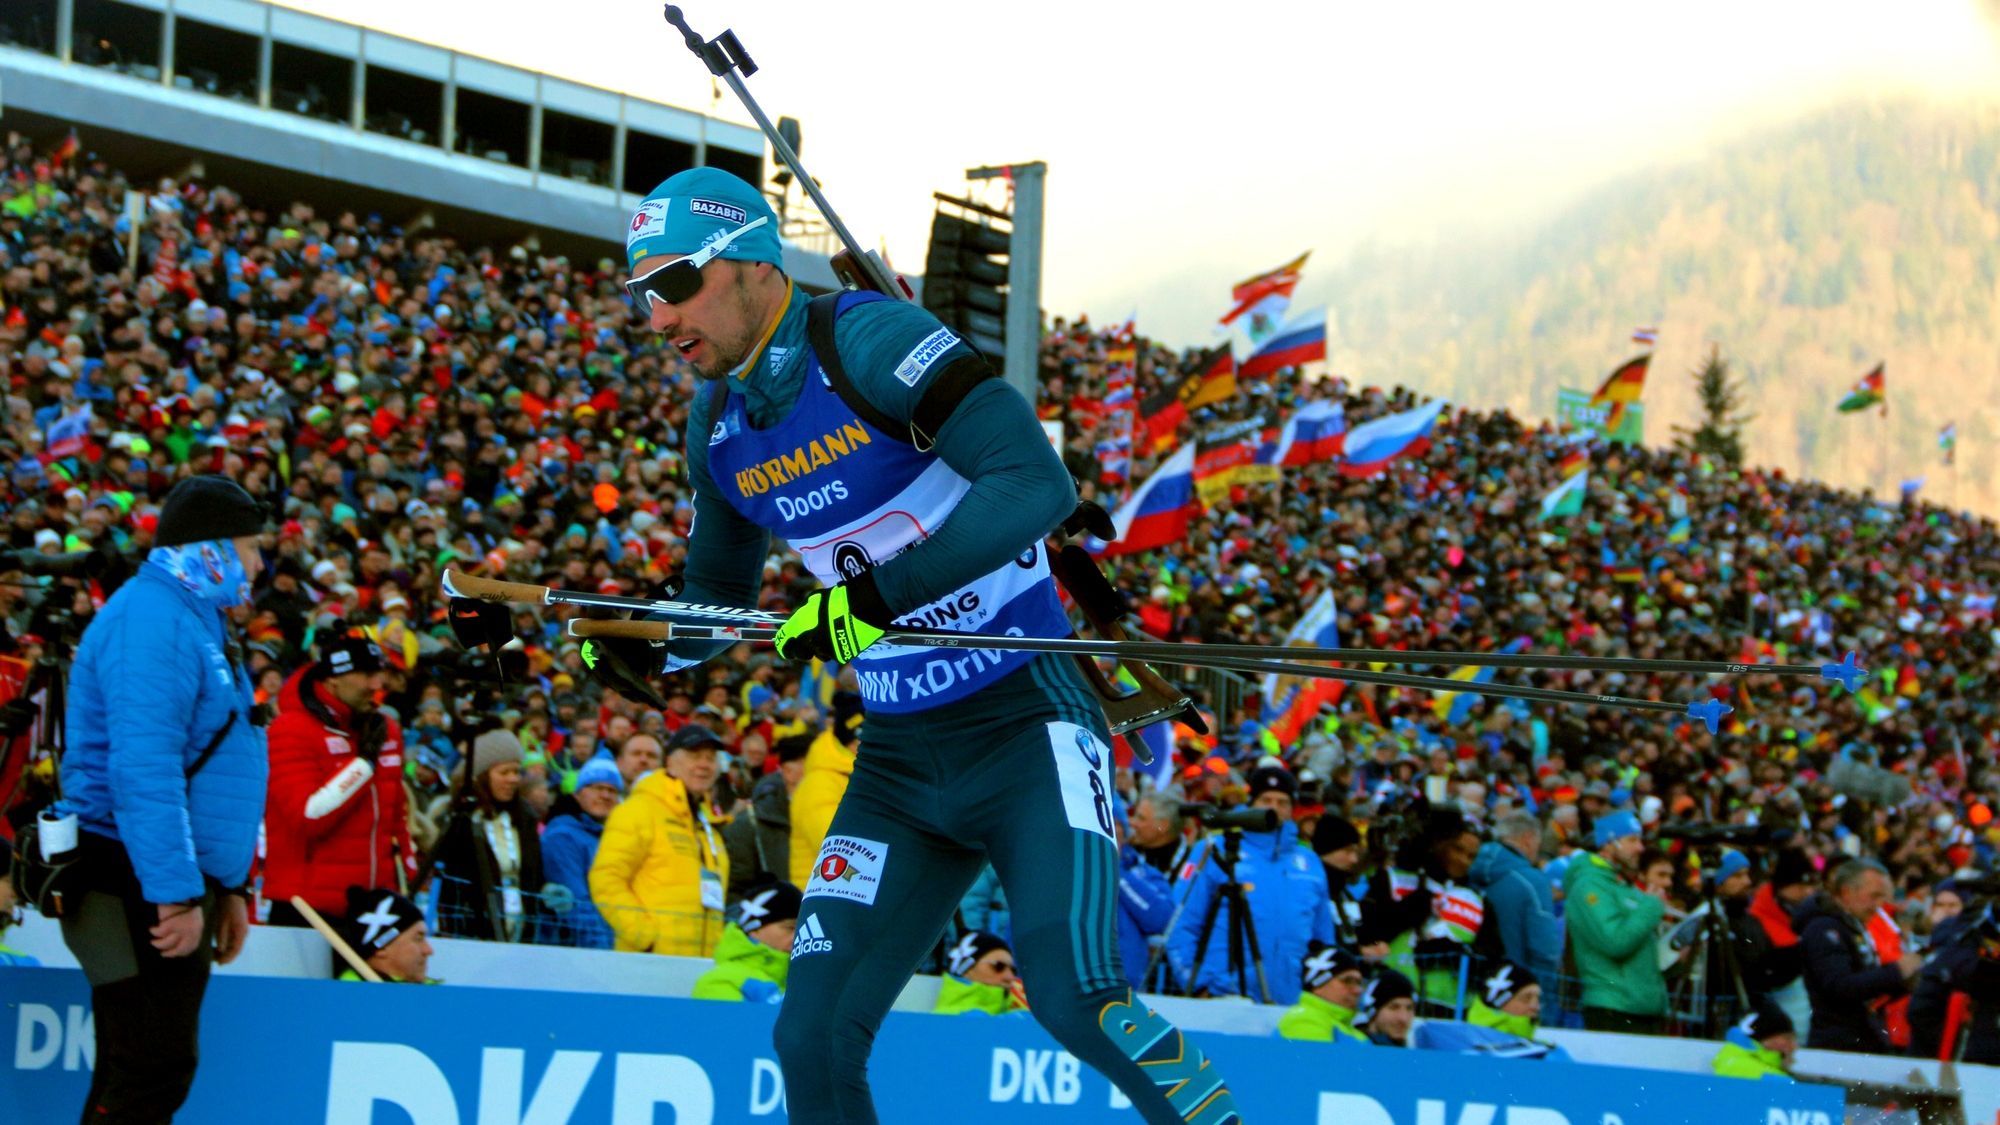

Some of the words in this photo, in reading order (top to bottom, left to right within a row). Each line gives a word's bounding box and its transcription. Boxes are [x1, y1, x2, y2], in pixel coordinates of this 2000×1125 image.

[692, 201, 745, 222] BAZABET
[735, 418, 872, 498] HÖRMANN
[775, 479, 849, 522] Doors
[954, 608, 988, 631] PEN
[855, 669, 899, 703] MW
[1088, 769, 1114, 839] 8
[834, 838, 878, 862] ПРИВАТНА
[858, 874, 877, 883] 2004
[790, 938, 833, 961] adidas
[14, 1002, 98, 1073] DK
[988, 1046, 1082, 1106] DKB
